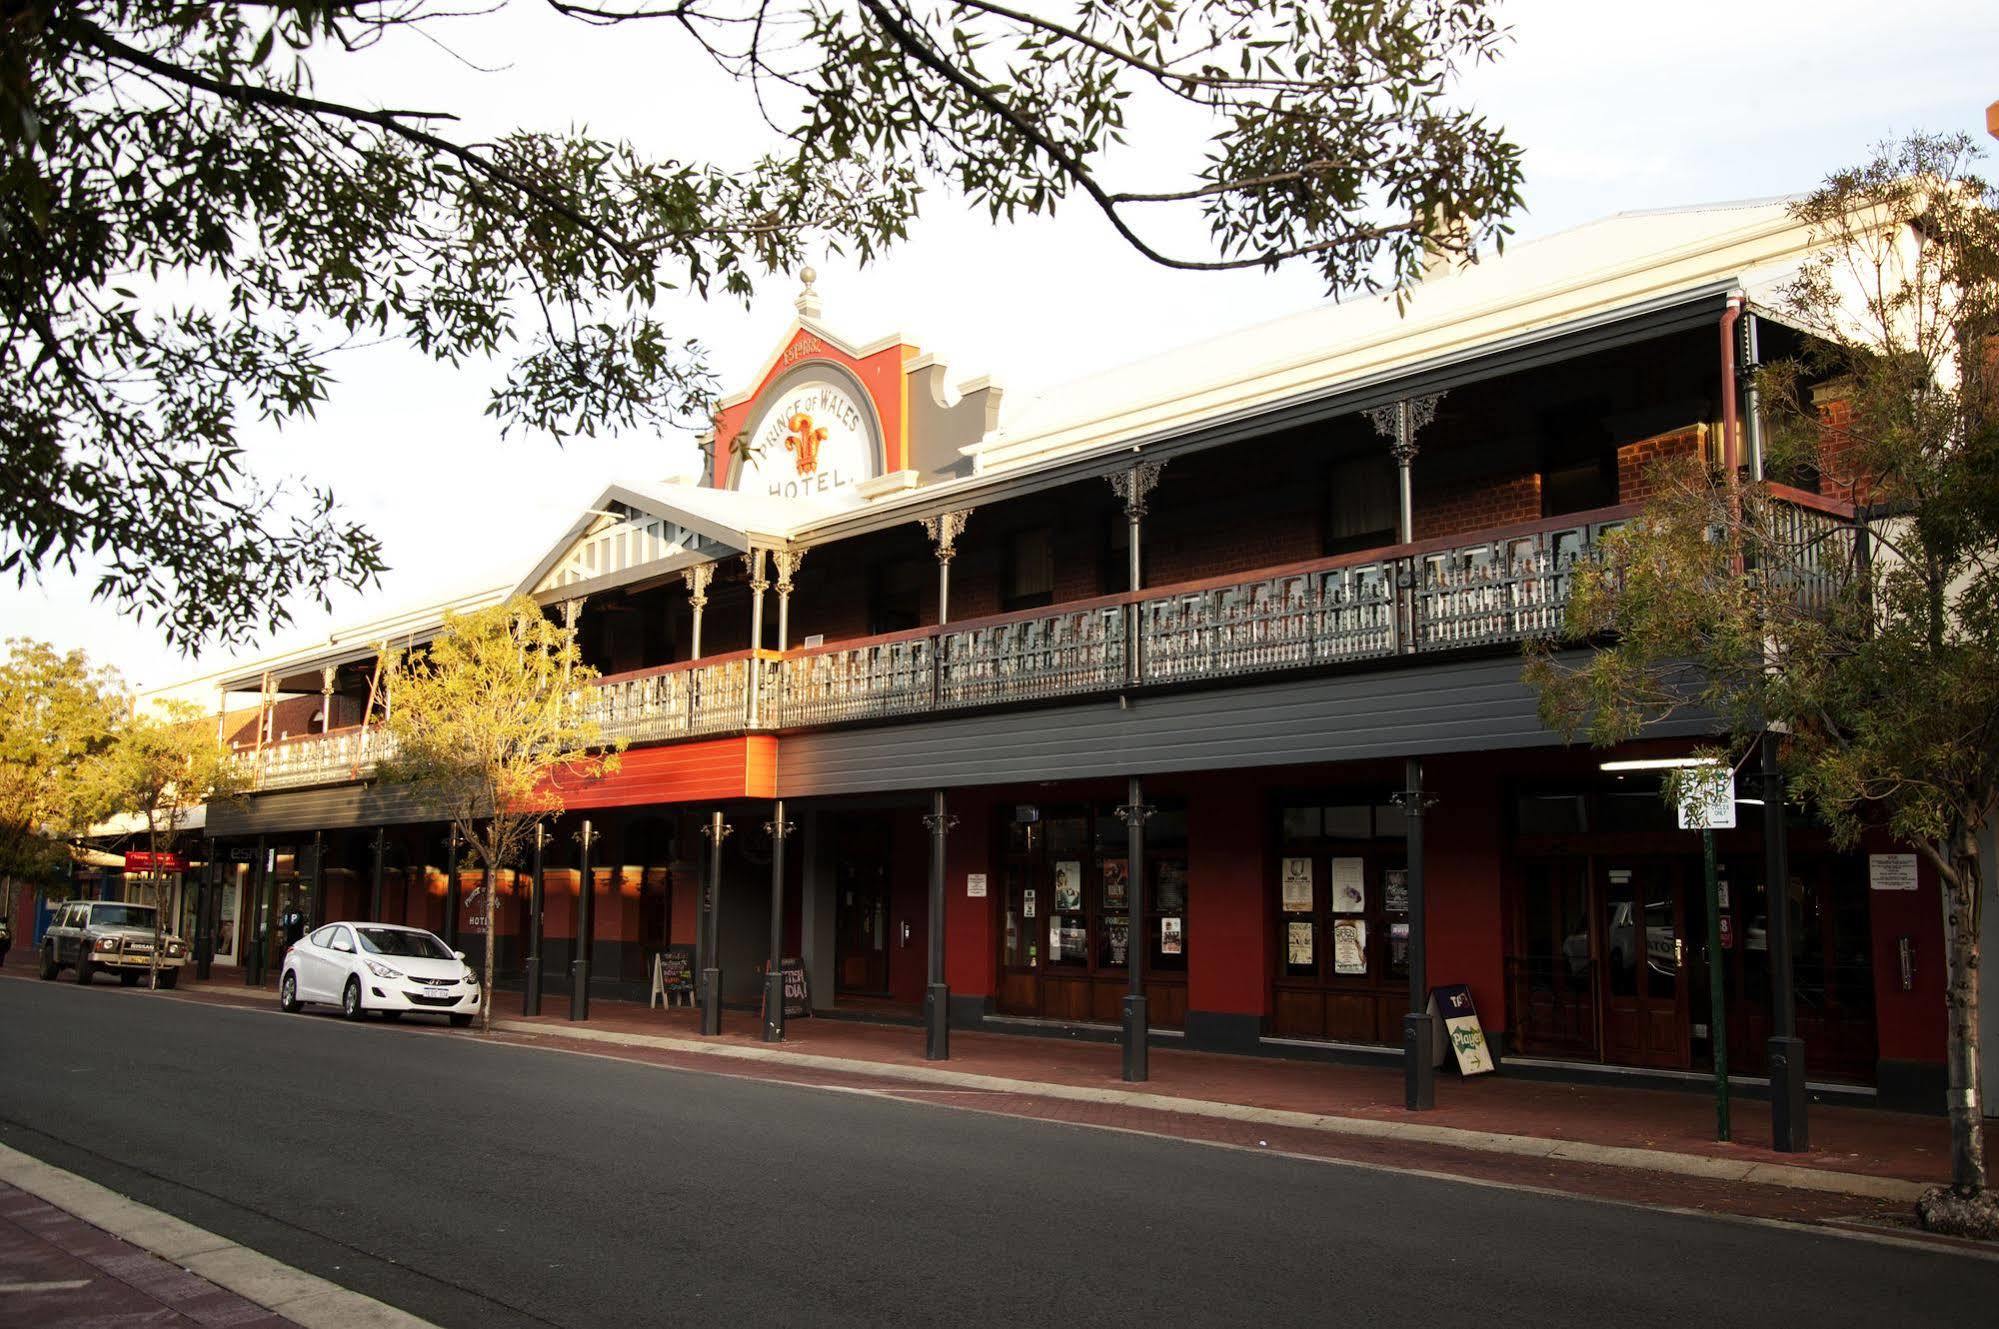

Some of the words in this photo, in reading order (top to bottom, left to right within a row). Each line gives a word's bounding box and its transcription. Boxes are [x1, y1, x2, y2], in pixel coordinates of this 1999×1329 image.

[759, 400, 801, 460] PRINCE
[805, 396, 817, 411] OF
[820, 389, 859, 431] WALES
